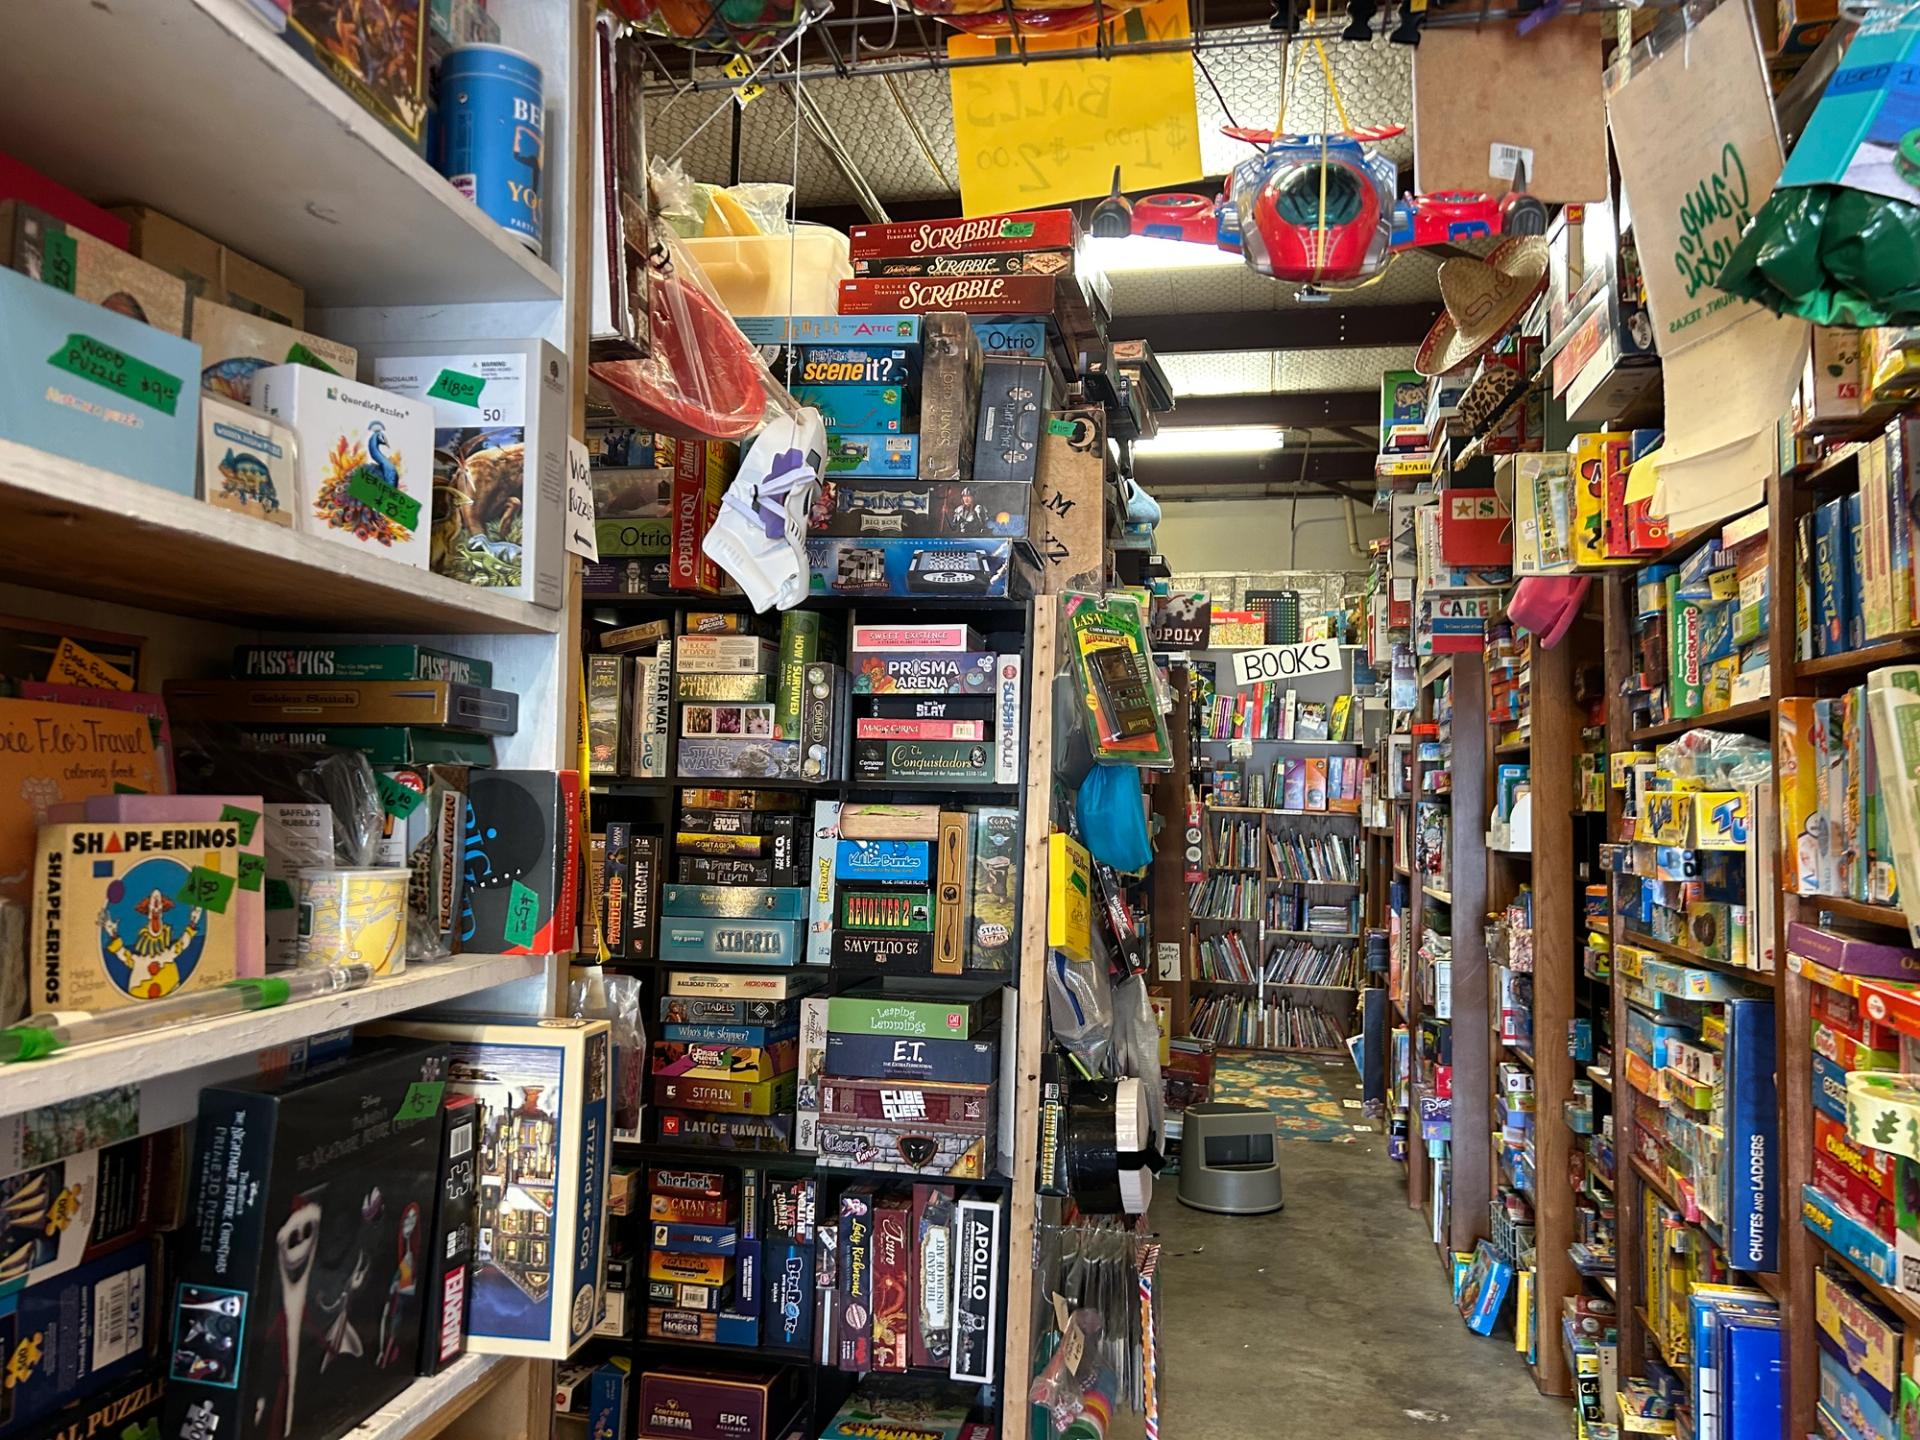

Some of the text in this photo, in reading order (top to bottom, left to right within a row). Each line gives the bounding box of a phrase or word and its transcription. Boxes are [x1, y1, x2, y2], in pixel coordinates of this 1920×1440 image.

[886, 233, 917, 241] TURNTABLE
[911, 217, 1011, 253] SCRABBLE
[926, 256, 1000, 277] SCRABBLE
[899, 278, 1005, 310] SCRABBLE
[853, 322, 895, 336] ATTIC
[988, 331, 1035, 349] Otrio
[79, 338, 126, 368] WOOD
[67, 349, 129, 389] PUZZLE
[379, 375, 419, 384] DINOSAURS
[803, 356, 893, 382] scene it?
[483, 409, 501, 422] 50
[680, 440, 695, 479] Fallout
[864, 518, 898, 527] BIG BOX
[620, 527, 671, 546] Otrio
[679, 493, 696, 577] OPERATION
[697, 619, 726, 632] ARCADE
[700, 613, 725, 625] PENNY
[793, 635, 805, 658] HOW
[870, 632, 948, 641] SWEET EXISTENCE
[1684, 605, 1699, 686] Restaurant
[246, 649, 335, 676] PASS PIGS
[420, 654, 470, 685] PASS PIGS
[888, 661, 960, 676] PRISMA
[1243, 642, 1331, 681] BOOKS
[789, 665, 803, 716] SURVIVED
[896, 676, 949, 688] ARENA
[916, 703, 947, 717] SLAY
[1003, 681, 1015, 730] SUSHI
[655, 705, 668, 736] WAR
[33, 717, 148, 756] Flo's Travel
[681, 746, 734, 758] STAR
[891, 745, 972, 770] Conquistadors
[64, 759, 137, 789] coloring book
[681, 757, 734, 770] WARS
[279, 808, 321, 818] BAFFLING
[281, 818, 321, 828] BUBBLES
[713, 817, 740, 825] WARS
[715, 823, 740, 832] STAR
[695, 841, 736, 850] CONTAGION
[440, 792, 459, 931] FLORIDA MAN
[711, 859, 755, 873] GAME GOES
[848, 853, 922, 868] Killer Bunnies
[716, 870, 749, 884] ELEVEN
[633, 861, 649, 929] WATERGATE
[607, 877, 623, 945] PANDEMIC
[848, 897, 910, 927] REVOLVER 2
[46, 851, 63, 1005] SHAPE-ERINOS
[981, 926, 1005, 935] STACK
[844, 940, 919, 955] 25 OUTLAWS
[981, 935, 1006, 944] ATTACK
[692, 1001, 736, 1017] CITADELS
[877, 1006, 917, 1022] Leaping
[679, 1024, 750, 1042] Who's the Skipper?
[870, 1016, 927, 1035] Lemmings
[893, 1040, 927, 1062] E.T.
[692, 1086, 732, 1100] STRAIN
[879, 1089, 925, 1105] CUBE
[883, 1103, 927, 1122] QUEST
[684, 1119, 727, 1134] LATICE
[823, 1132, 868, 1153] Castle
[1042, 1103, 1057, 1186] CASINO BLACKJACK
[226, 1126, 246, 1182] NIGHTMARE
[584, 1118, 597, 1194] PUZZLE
[855, 1146, 880, 1164] Panic
[200, 1126, 228, 1254] PRIME 3D PUZZLE
[657, 1171, 713, 1190] Sherlock
[222, 1183, 239, 1220] BEFORE
[671, 1197, 705, 1211] CATAN
[1748, 1134, 1766, 1263] CHUTES AND LADDERS
[777, 1192, 788, 1231] ZOMBIES
[797, 1190, 806, 1234] BUTTON
[806, 1201, 815, 1225] MEN
[214, 1221, 235, 1274] CHRISTMAS
[579, 1222, 592, 1271] 500
[882, 1218, 904, 1266] Tsuro
[851, 1217, 868, 1299] Lady Richmond
[928, 1250, 936, 1285] GRAND
[972, 1221, 990, 1300] APOLLO
[936, 1238, 946, 1315] MUSEUM OF ART
[961, 1257, 970, 1297] MISSIONS
[650, 1283, 674, 1295] EXIT
[441, 1265, 466, 1362] MARVEL
[663, 1320, 699, 1334] HORSES
[650, 1415, 693, 1430] ARENA
[719, 1413, 748, 1426] EPIC
